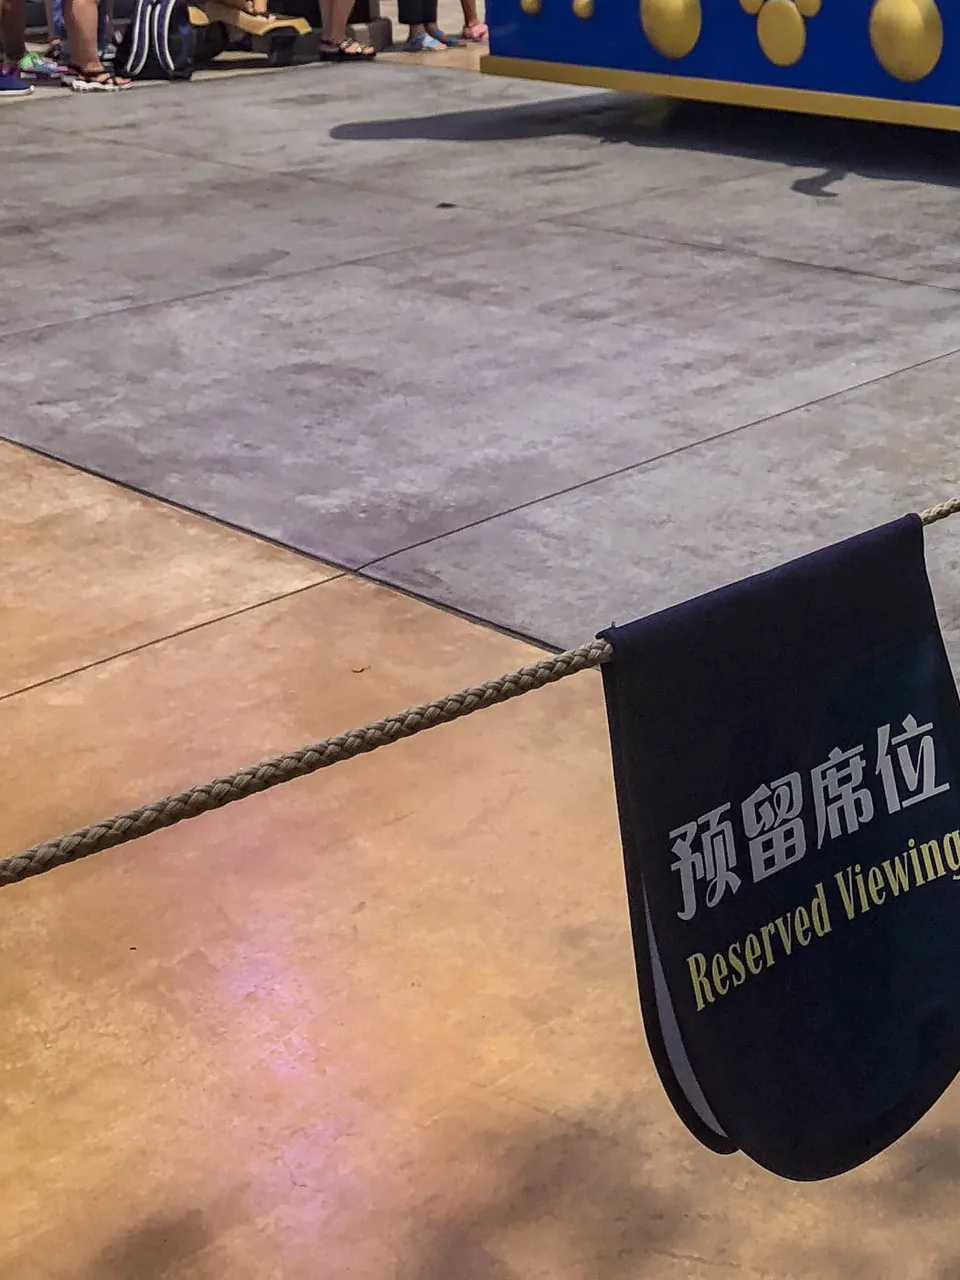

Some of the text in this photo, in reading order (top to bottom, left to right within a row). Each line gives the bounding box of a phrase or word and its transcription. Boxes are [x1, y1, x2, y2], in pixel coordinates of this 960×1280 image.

[668, 713, 951, 921] 预留席位
[686, 882, 833, 1012] Reserved
